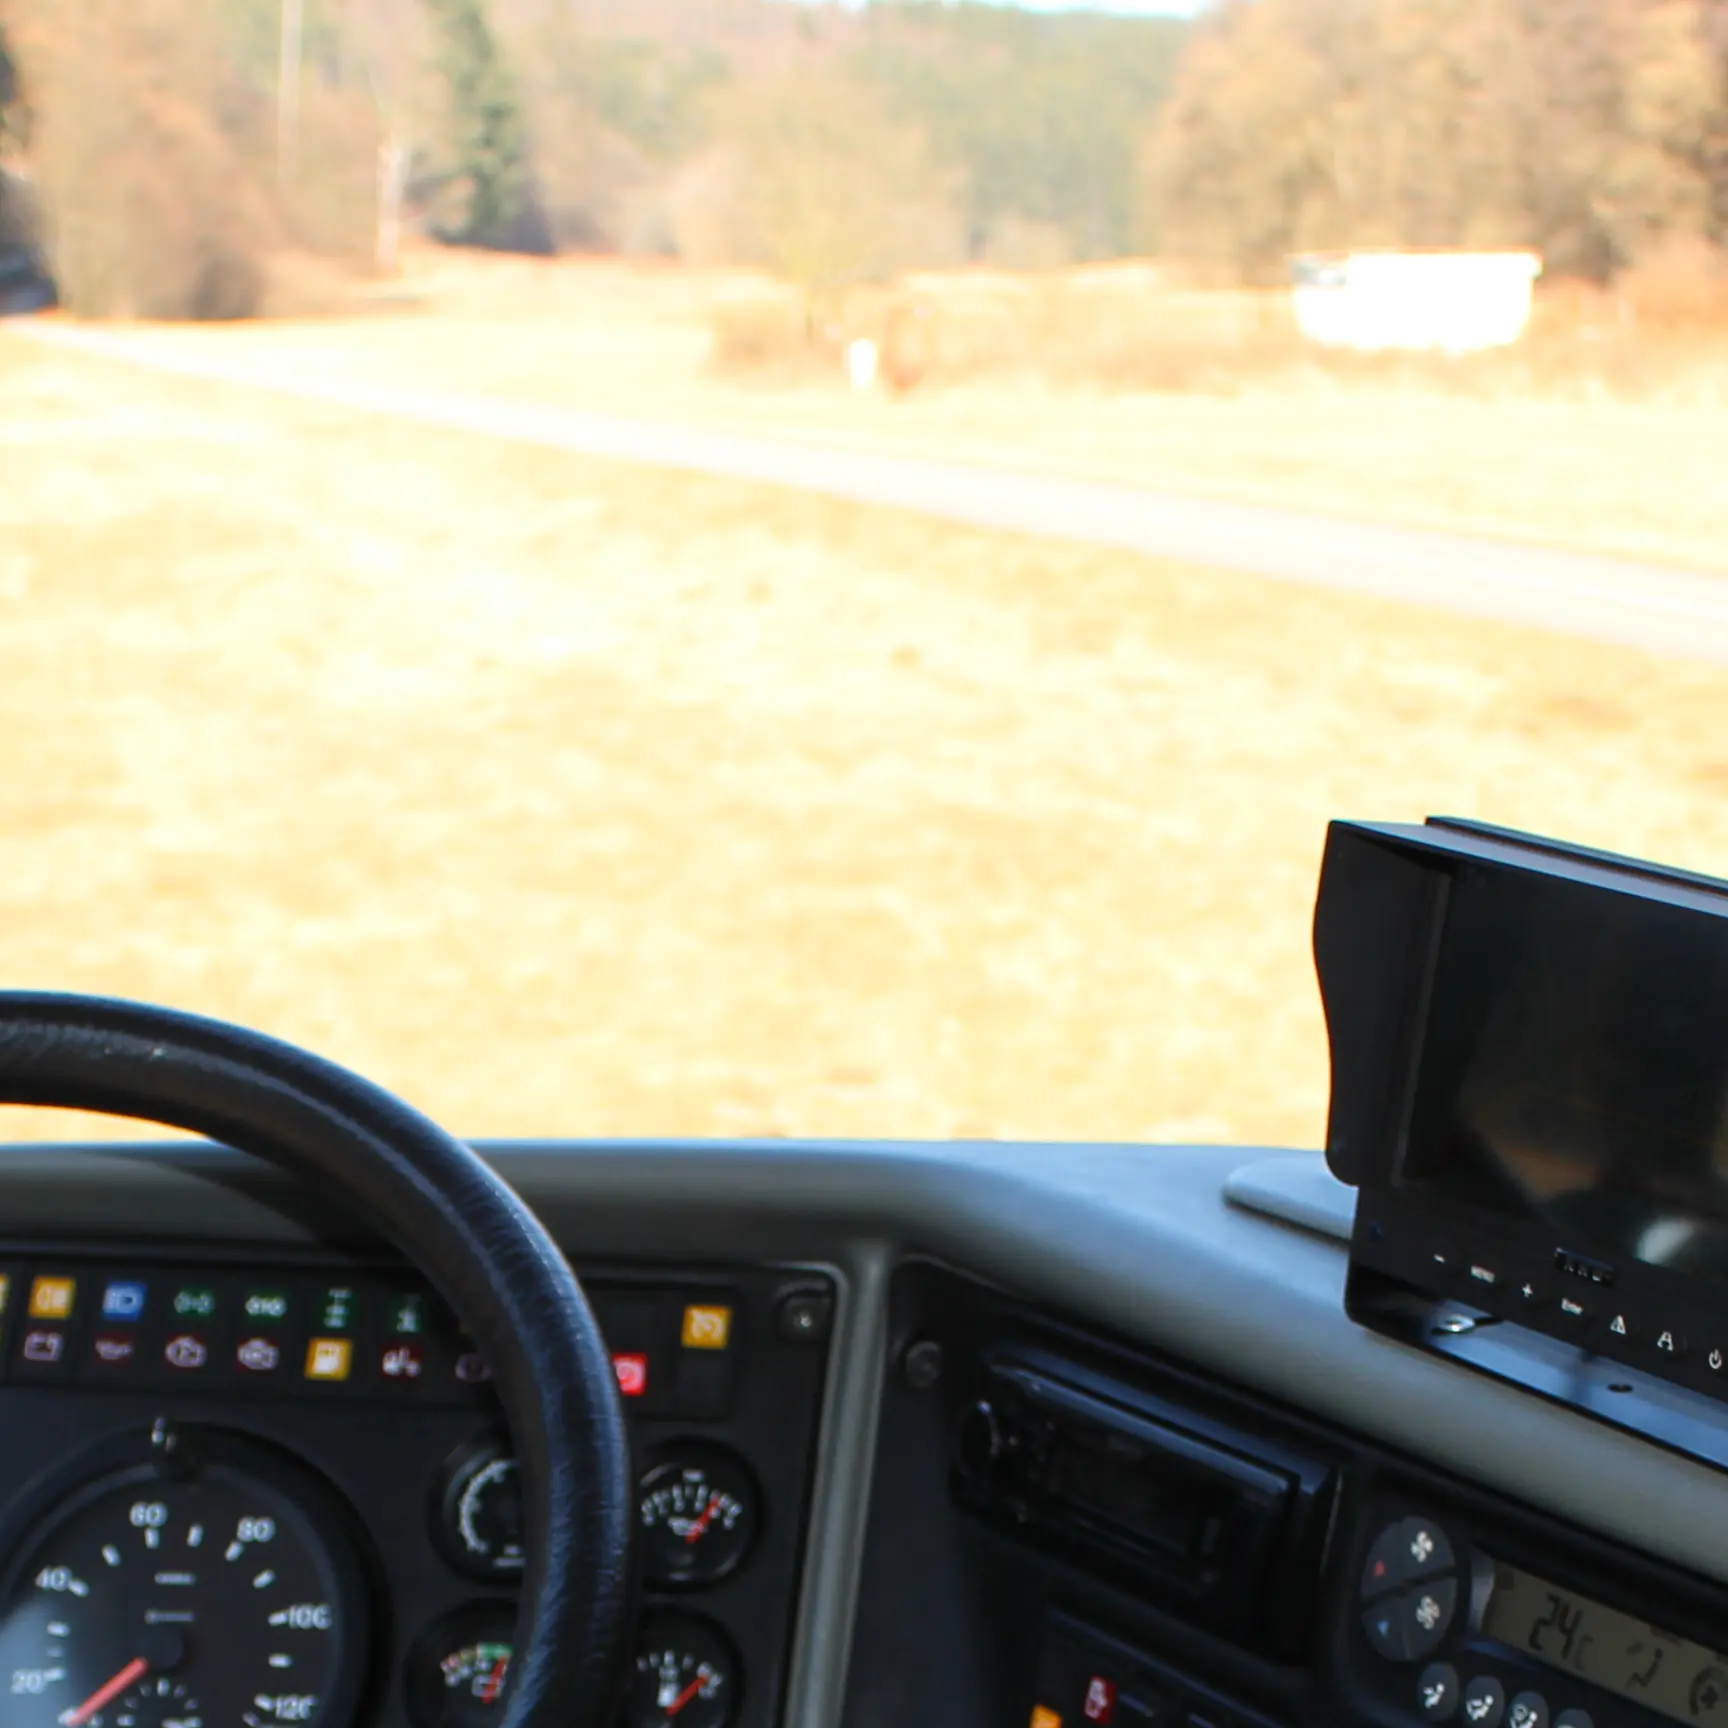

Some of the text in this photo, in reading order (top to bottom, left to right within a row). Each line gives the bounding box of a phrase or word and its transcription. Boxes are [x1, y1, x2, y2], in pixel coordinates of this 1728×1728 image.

[129, 1502, 168, 1528] 60
[237, 1516, 275, 1542] 80
[36, 1566, 70, 1592] 40
[11, 1668, 46, 1694] 20
